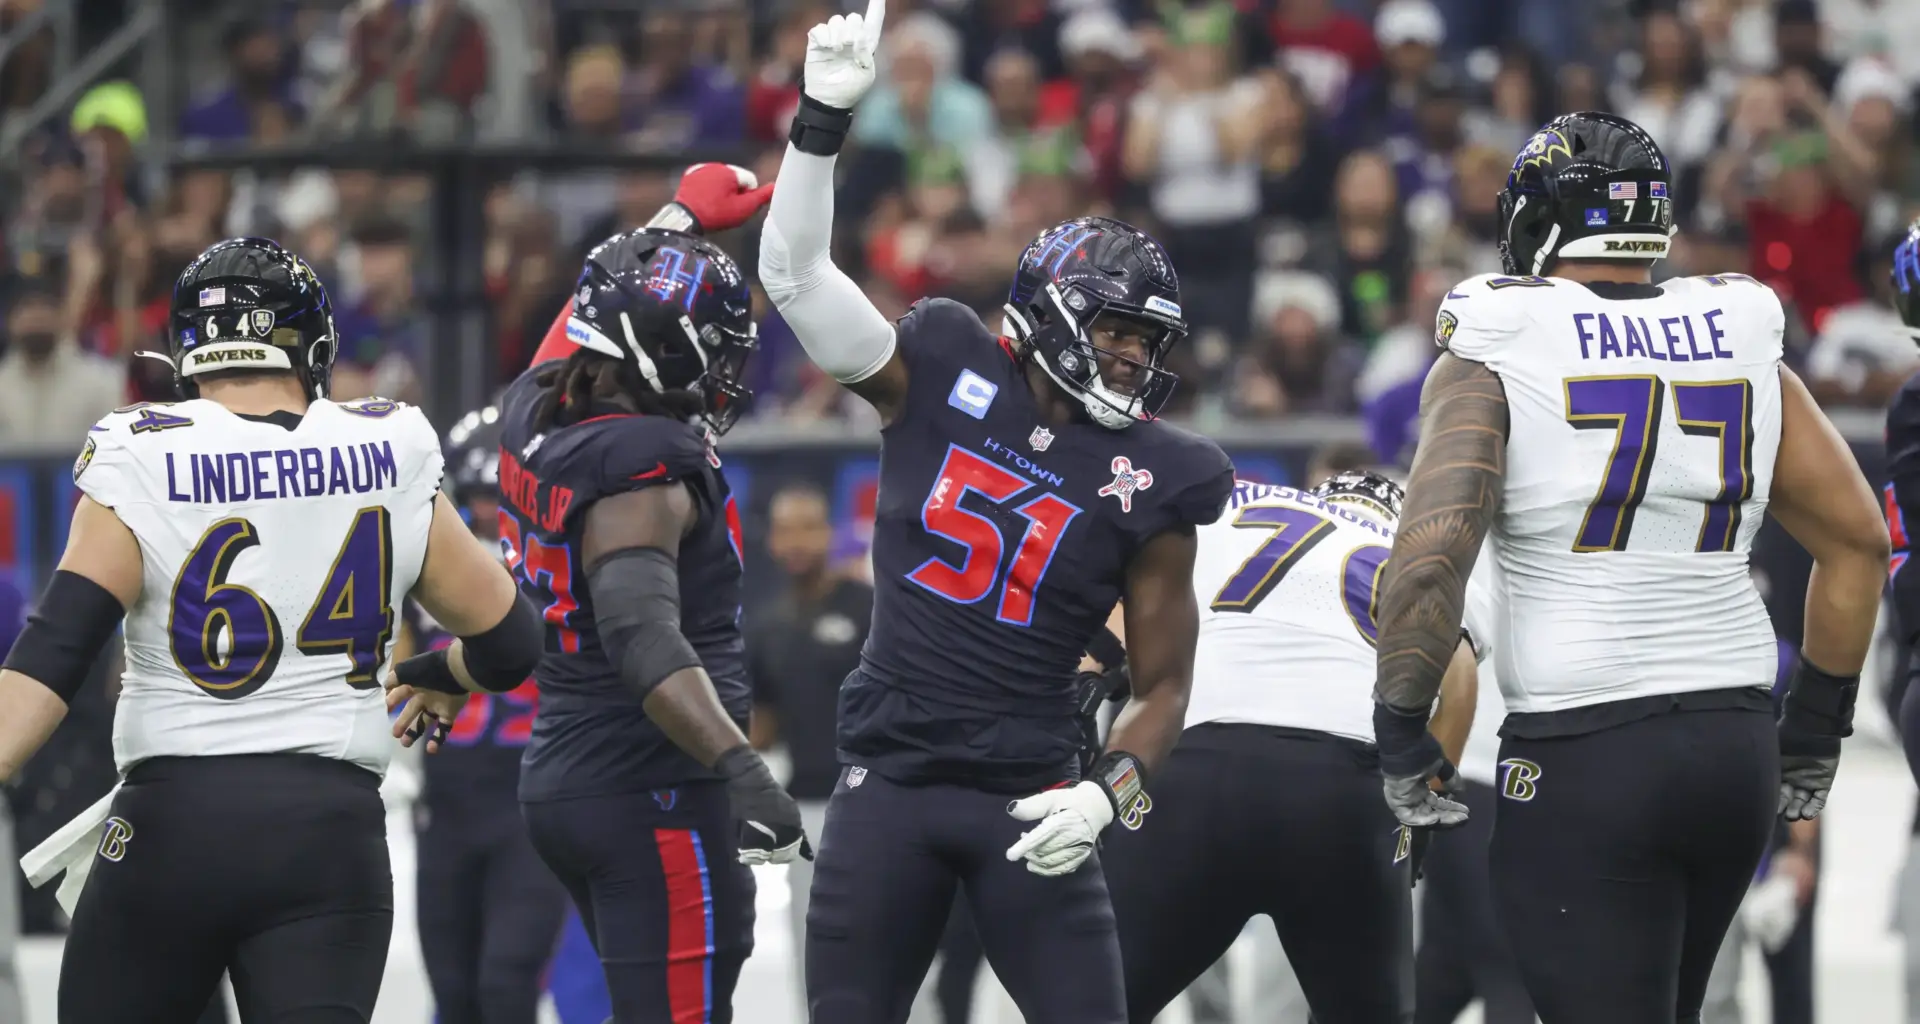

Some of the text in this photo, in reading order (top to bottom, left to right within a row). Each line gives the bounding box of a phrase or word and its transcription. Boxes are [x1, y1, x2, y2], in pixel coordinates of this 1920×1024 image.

[1624, 200, 1636, 222] 7
[1651, 200, 1660, 222] 7
[1604, 240, 1668, 255] RAVENS
[206, 315, 219, 339] 6
[235, 313, 250, 336] 4
[1573, 308, 1734, 362] FAALELE
[192, 349, 267, 365] RAVENS
[957, 374, 993, 408] C
[166, 440, 398, 504] LINDERBAUM
[984, 437, 1065, 487] H-TOWN
[1562, 374, 1755, 553] 77
[541, 485, 575, 533] JR
[904, 441, 1085, 627] 51
[169, 505, 395, 700] 64
[1500, 758, 1542, 802] B
[99, 817, 133, 862] B
